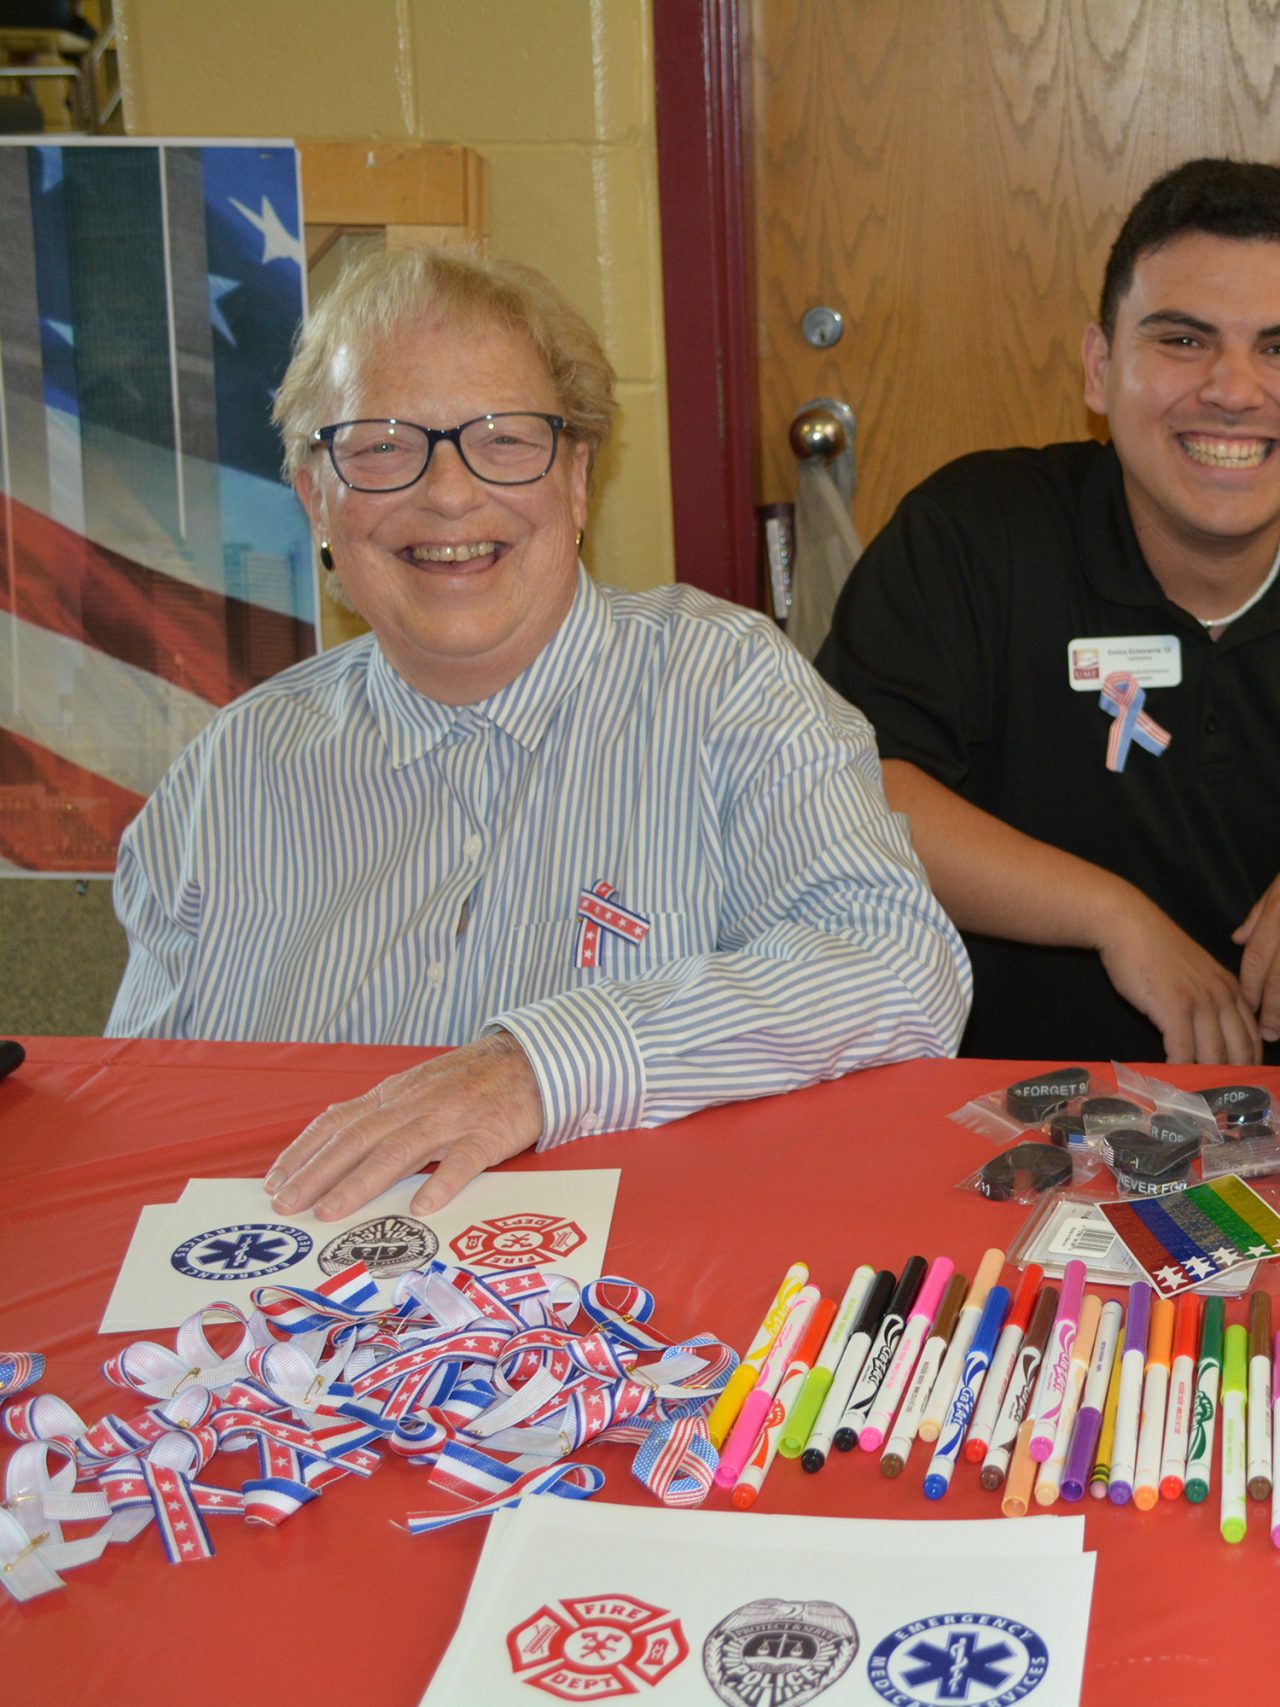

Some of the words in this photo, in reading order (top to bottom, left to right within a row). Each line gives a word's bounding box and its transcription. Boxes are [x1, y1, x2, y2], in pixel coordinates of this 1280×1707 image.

[1023, 1084, 1077, 1097] FORGET
[1119, 1171, 1157, 1194] NEVER
[502, 1219, 547, 1227] DEPT
[174, 1224, 253, 1258] SERVICES
[264, 1224, 311, 1254] MEDICAL
[348, 1229, 421, 1244] POLICE
[490, 1255, 536, 1264] FIRE
[180, 1262, 290, 1280] EMERGENCY
[583, 1604, 642, 1620] FIRE
[894, 1614, 1033, 1641] EMERGENCY
[550, 1672, 613, 1690] DEPT
[726, 1664, 821, 1688] POLICE
[871, 1656, 935, 1707] MEDICA
[970, 1656, 1046, 1707] RVICES
